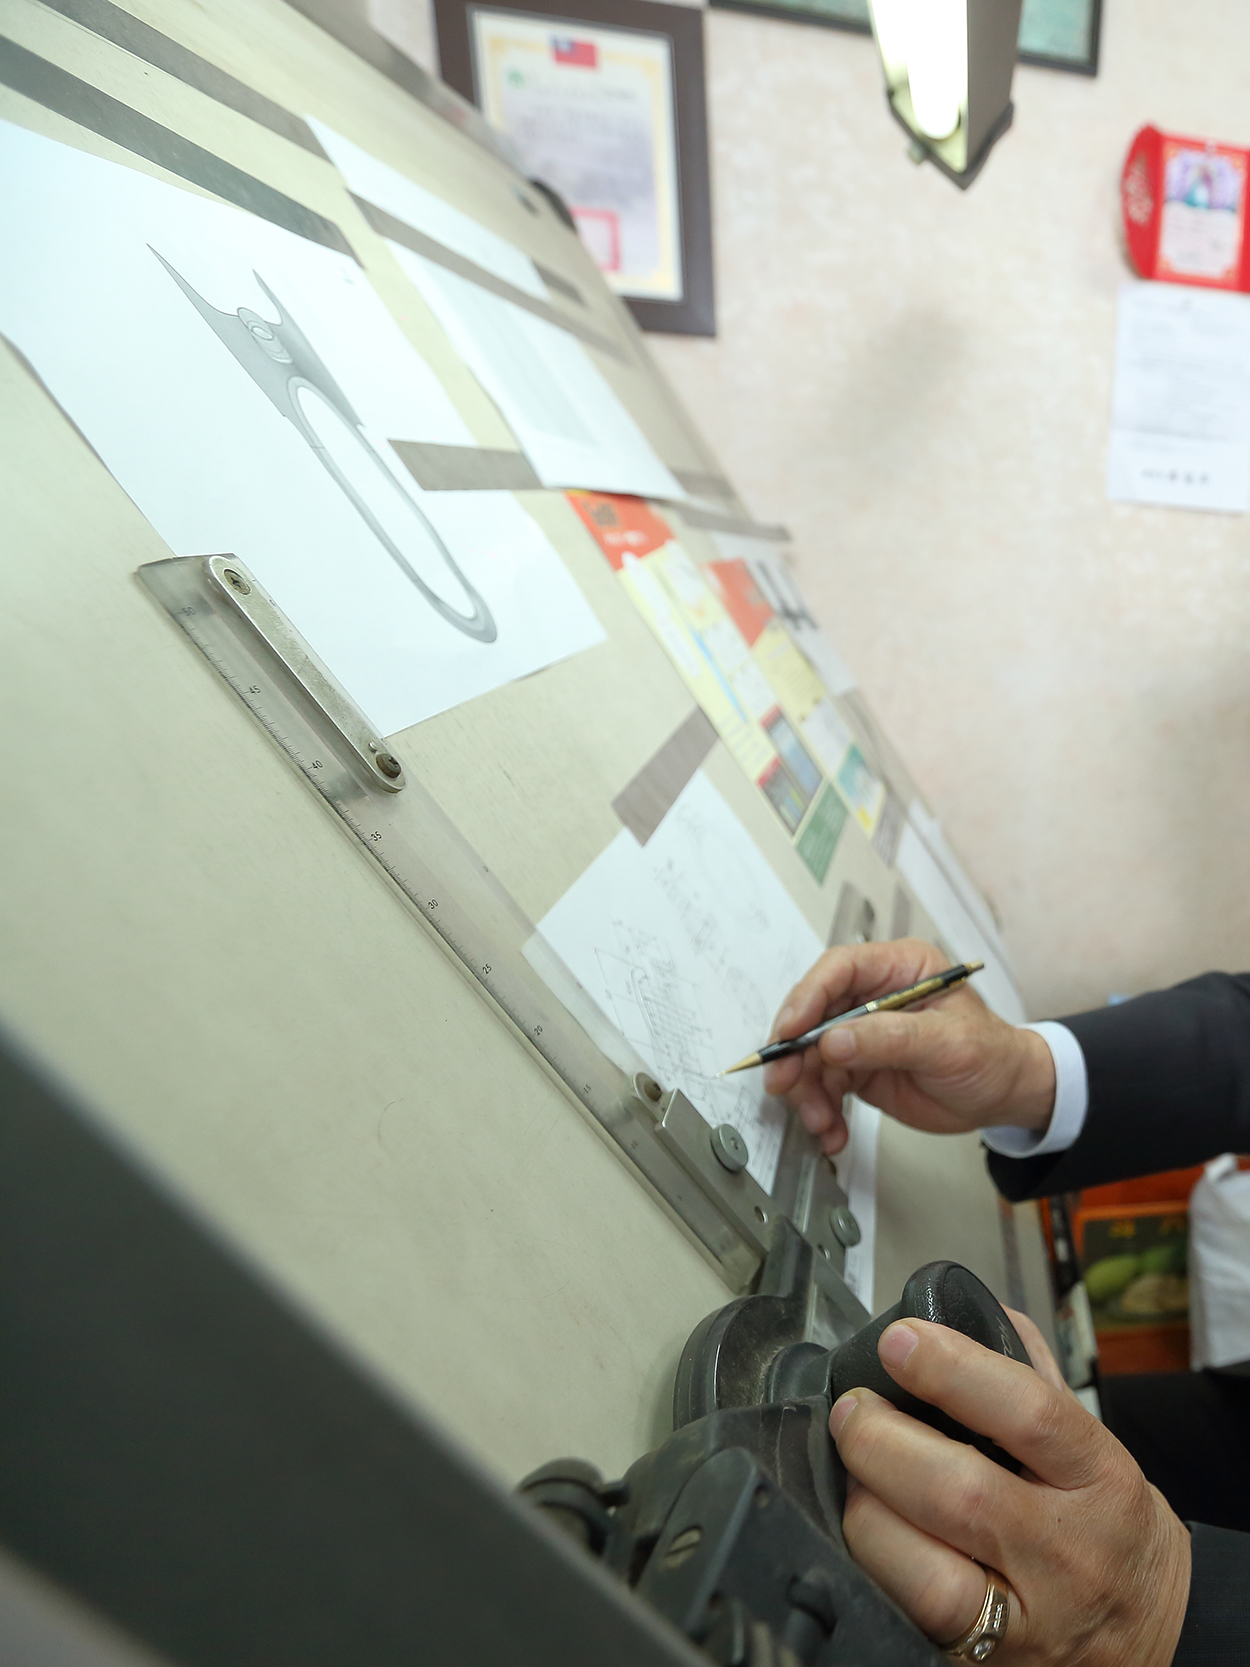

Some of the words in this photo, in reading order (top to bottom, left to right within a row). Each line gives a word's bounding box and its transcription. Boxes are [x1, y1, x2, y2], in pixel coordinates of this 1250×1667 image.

[182, 606, 196, 617] 50
[249, 684, 261, 695] 45
[312, 760, 323, 770] 40
[371, 831, 383, 841] 35
[428, 899, 439, 910] 30
[482, 964, 492, 974] 25
[534, 1025, 543, 1036] 20
[583, 1083, 592, 1094] 15
[630, 1140, 639, 1150] 10
